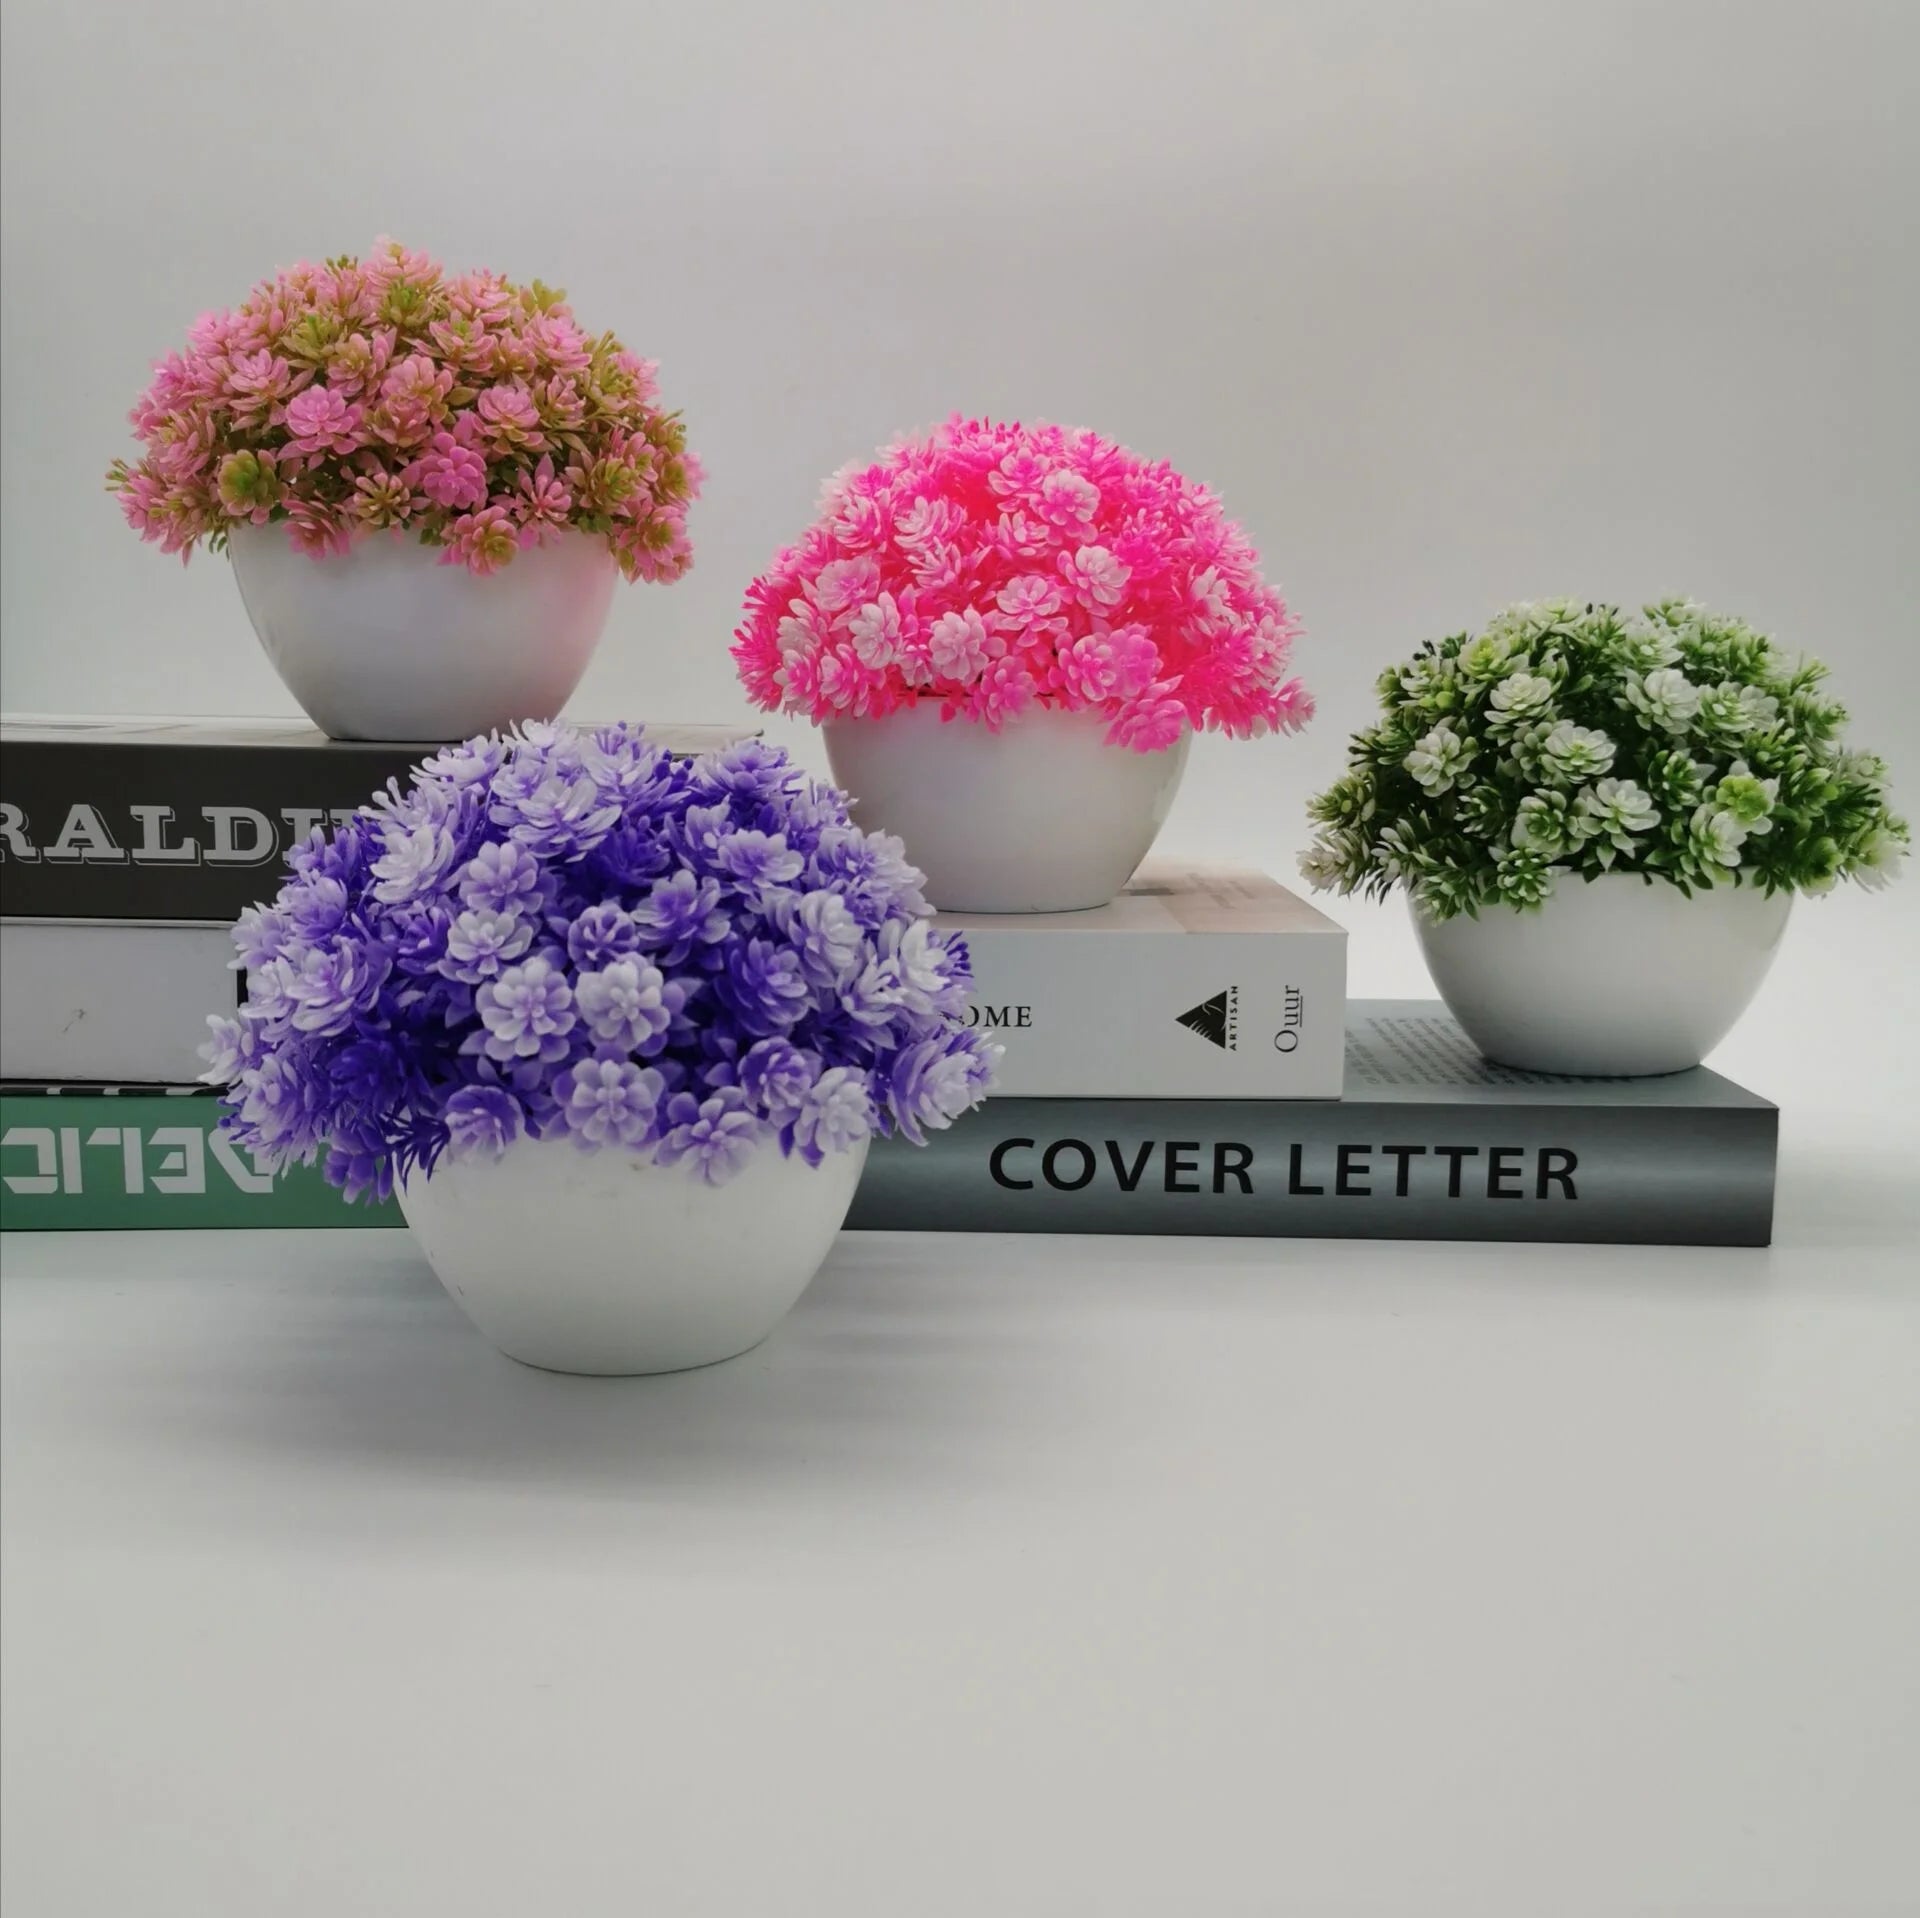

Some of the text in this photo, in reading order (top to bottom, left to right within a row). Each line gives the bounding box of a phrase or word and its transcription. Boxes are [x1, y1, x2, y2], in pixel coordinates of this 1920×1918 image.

[1228, 985, 1239, 1051] ARTISAN
[1273, 985, 1303, 1053] Ouur
[989, 1137, 1578, 1200] COVER LETTER
